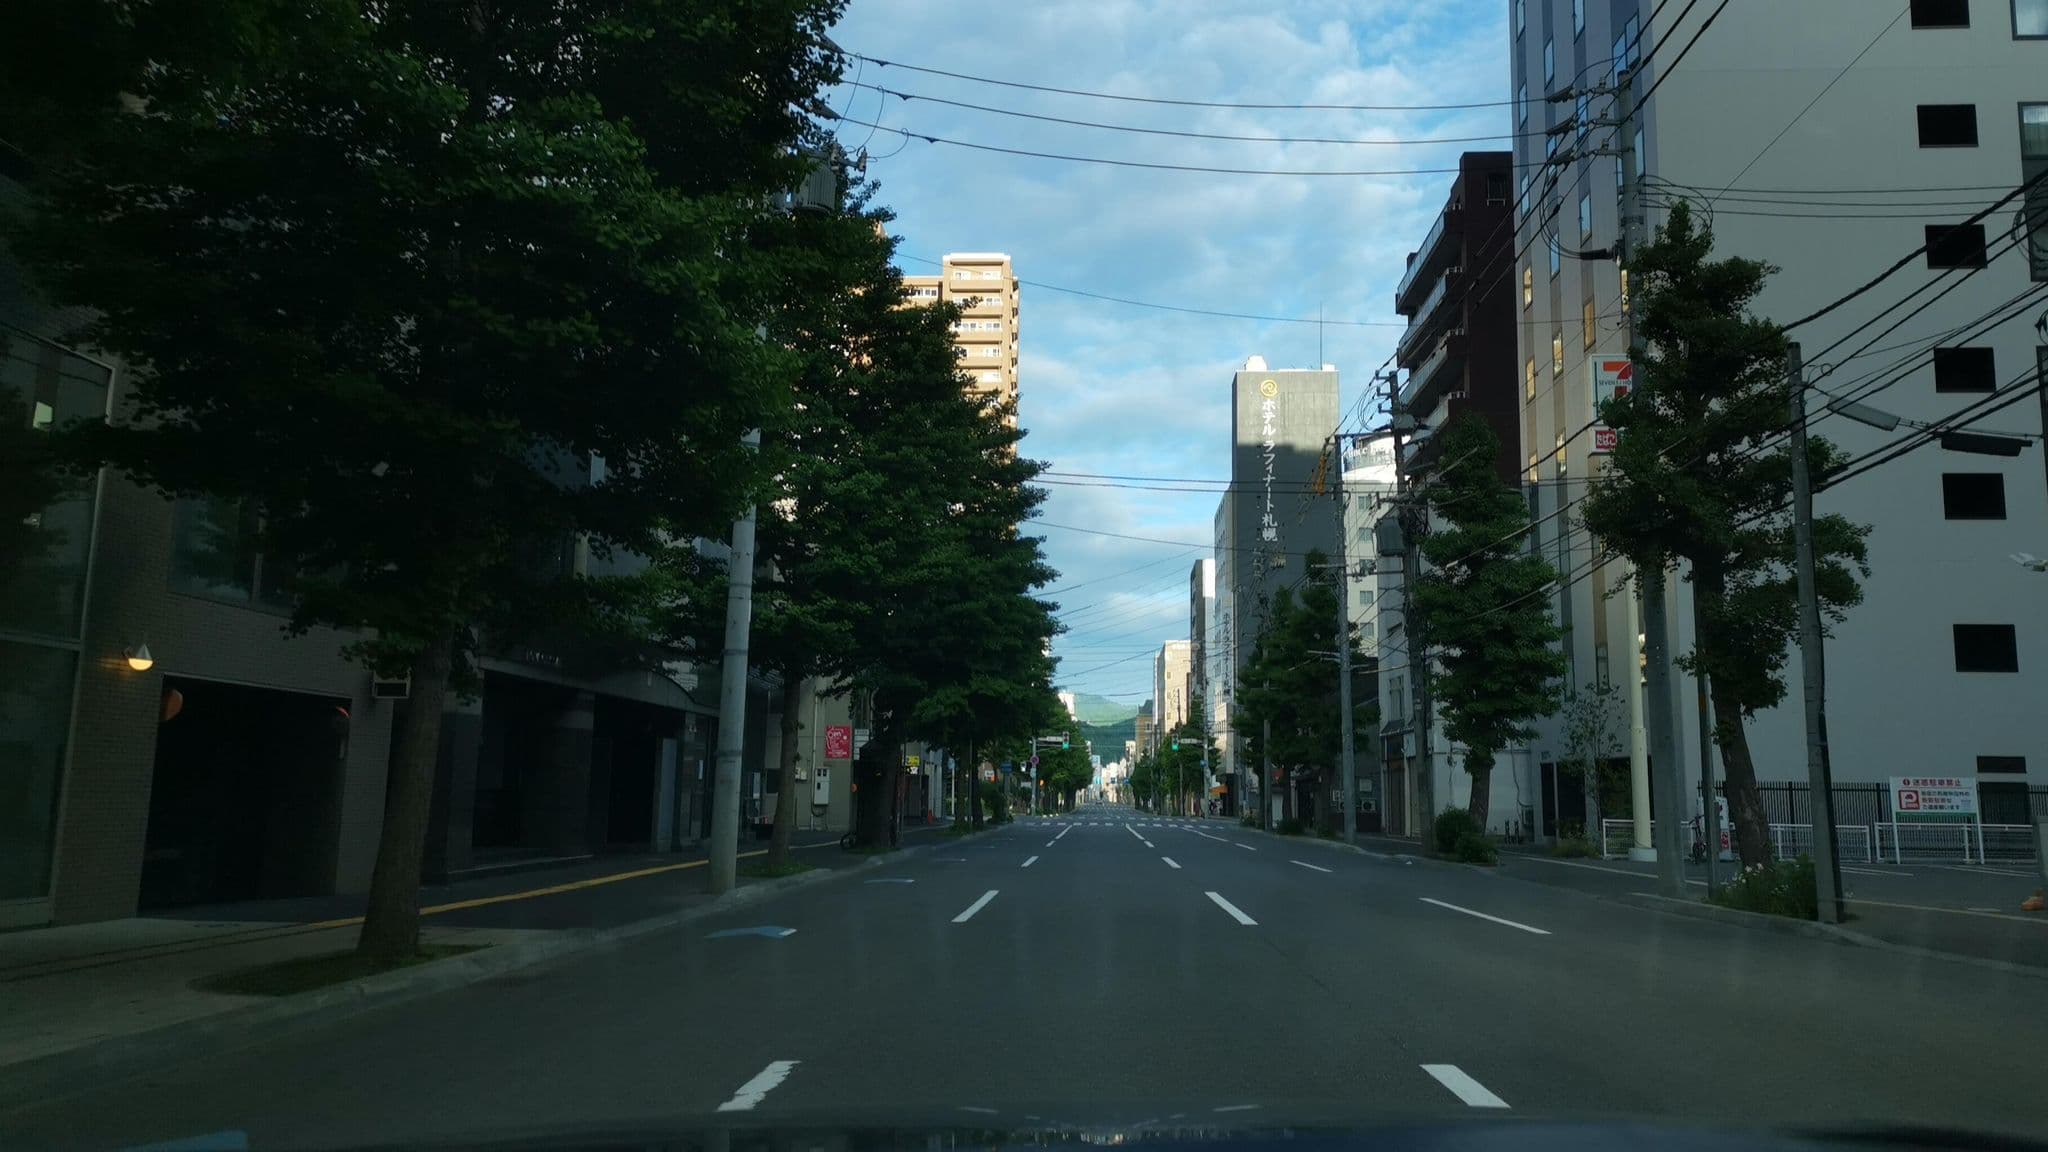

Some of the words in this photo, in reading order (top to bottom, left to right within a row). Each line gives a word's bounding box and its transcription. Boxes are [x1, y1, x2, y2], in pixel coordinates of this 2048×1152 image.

[1262, 400, 1278, 541] ホテルラフィナート札幌
